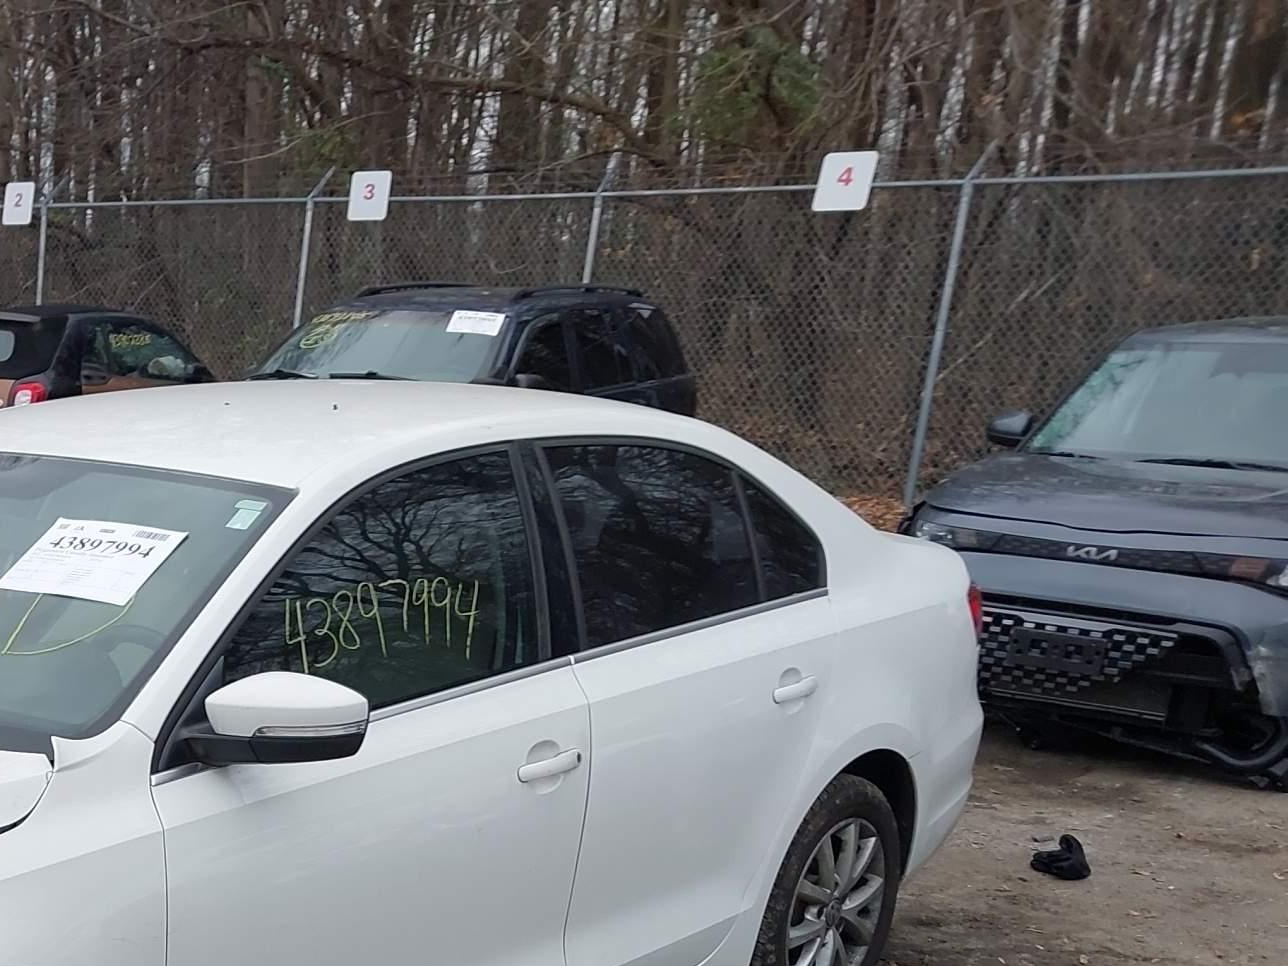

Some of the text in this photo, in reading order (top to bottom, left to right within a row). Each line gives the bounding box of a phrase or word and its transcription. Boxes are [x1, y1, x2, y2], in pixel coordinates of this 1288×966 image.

[837, 167, 853, 186] 4
[14, 193, 23, 207] 2
[363, 184, 375, 200] 3
[49, 535, 156, 559] 43897994
[1067, 545, 1119, 561] KIA
[285, 576, 480, 674] 43897994
